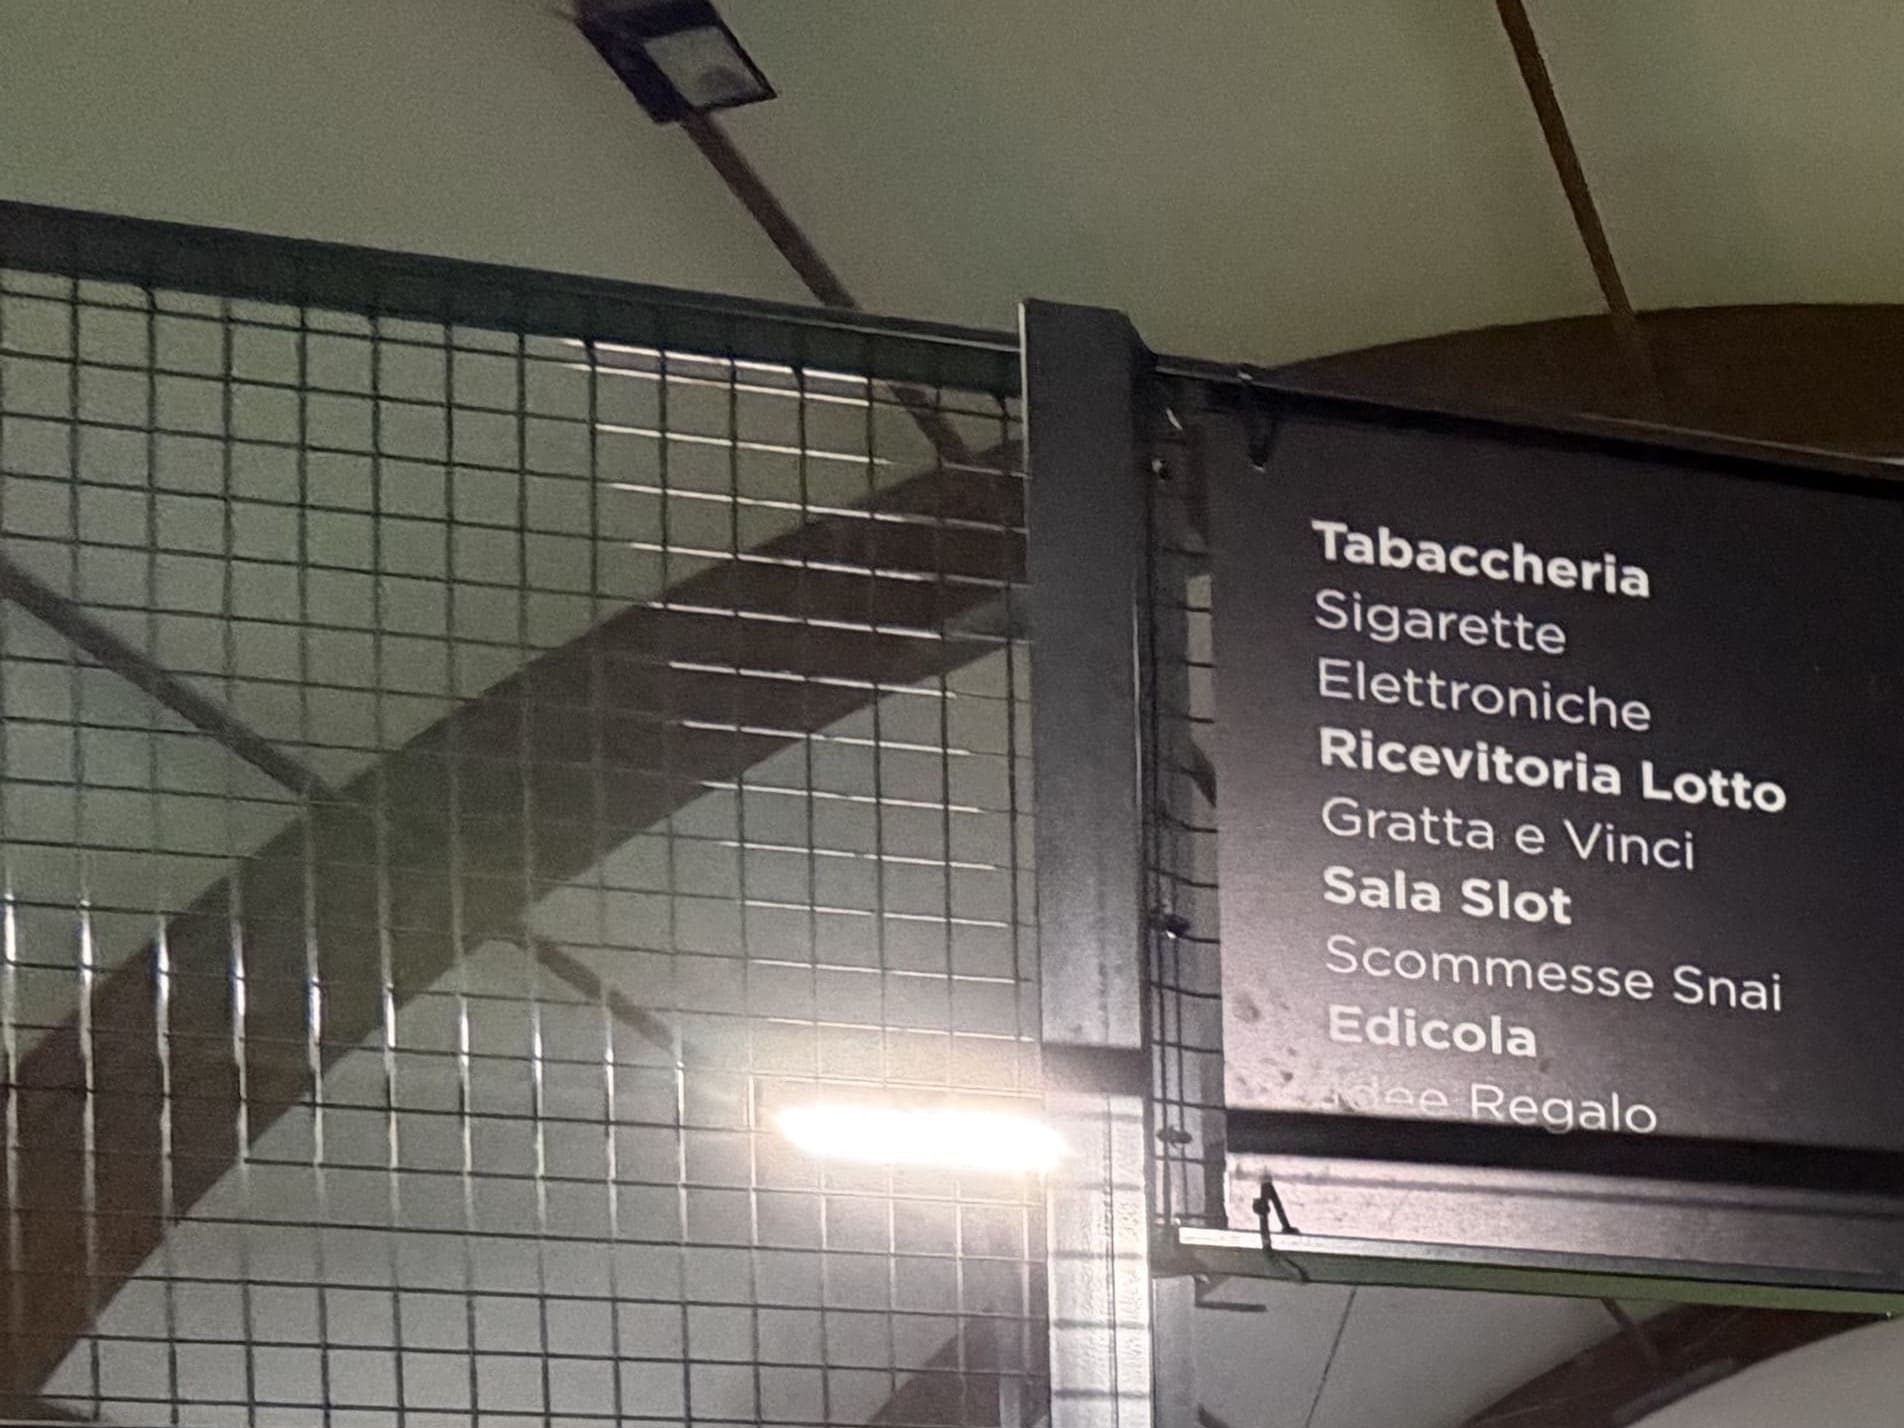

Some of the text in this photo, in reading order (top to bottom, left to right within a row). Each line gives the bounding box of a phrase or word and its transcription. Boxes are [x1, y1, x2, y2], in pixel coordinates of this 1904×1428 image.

[1312, 519, 1650, 598] Tabaccheria
[1314, 588, 1567, 655] Sigarette
[1319, 658, 1652, 732] Elettroniche
[1321, 727, 1787, 812] Ricevitoria Lotto
[1322, 798, 1696, 871] Gratta e Vinci
[1323, 865, 1572, 926] Sala Slot
[1326, 936, 1783, 1012] Scommesse Snai
[1329, 1005, 1538, 1059] Edicola
[1333, 1072, 1658, 1134] dee Regalo
